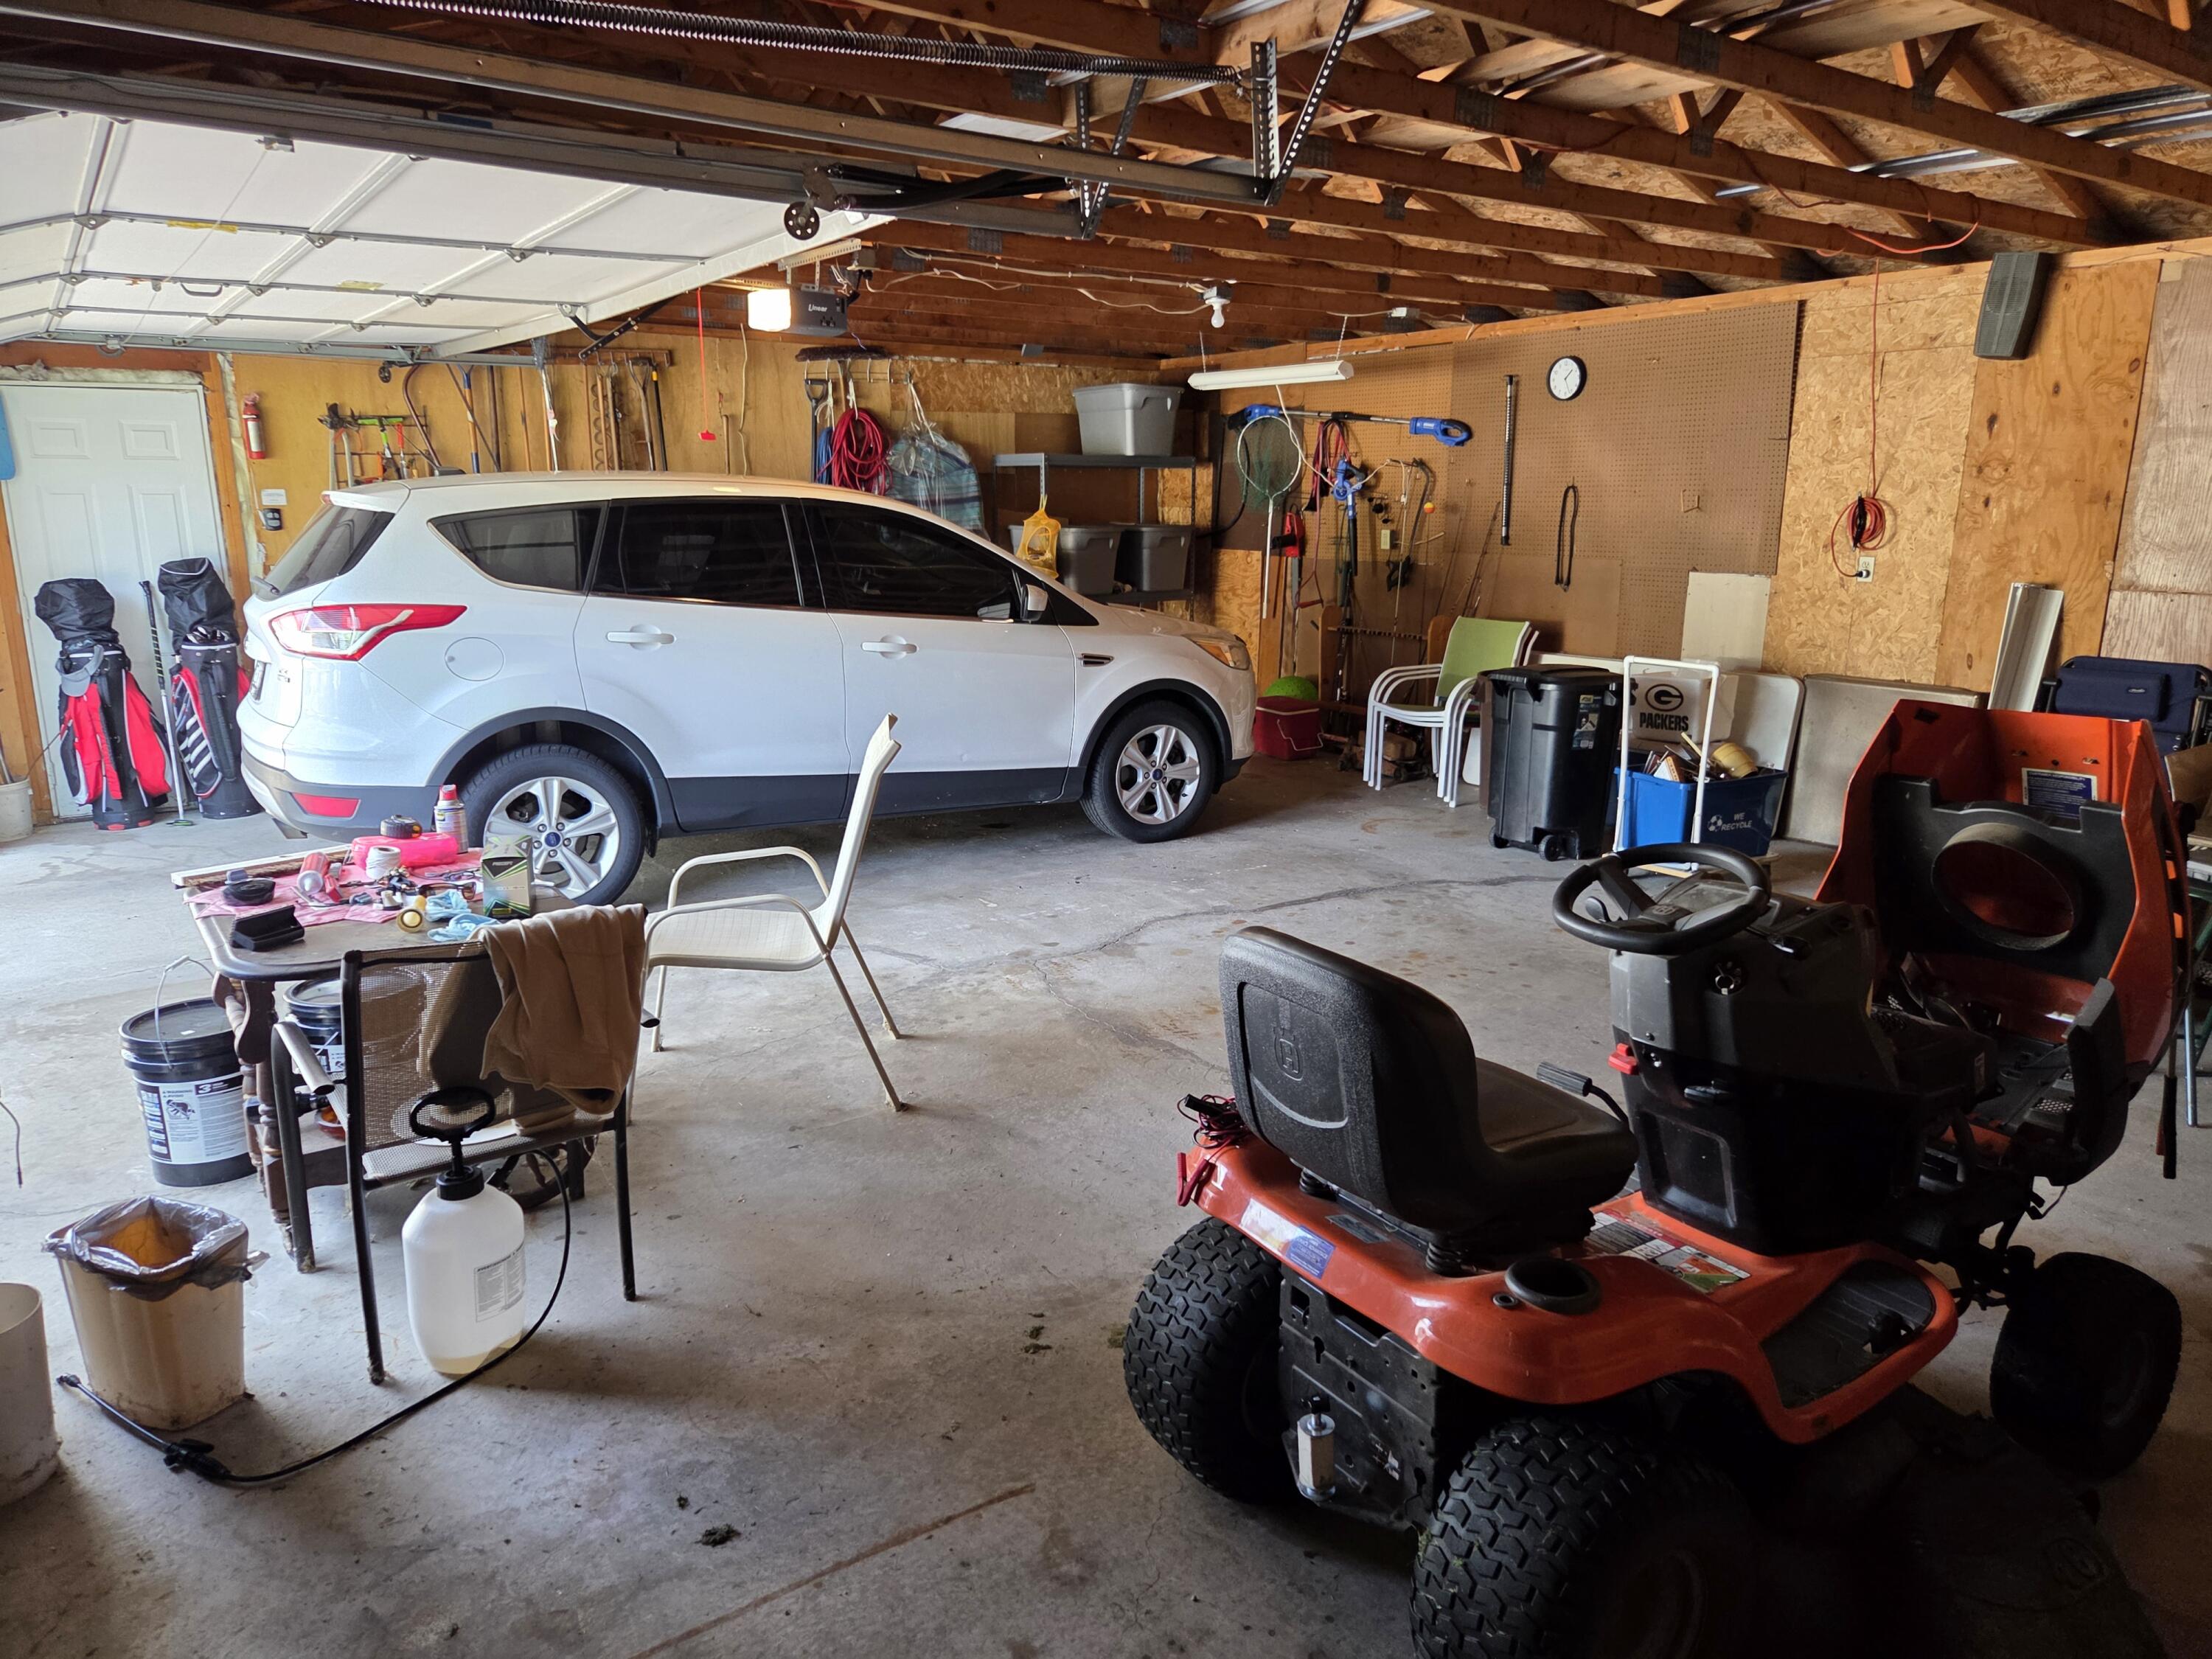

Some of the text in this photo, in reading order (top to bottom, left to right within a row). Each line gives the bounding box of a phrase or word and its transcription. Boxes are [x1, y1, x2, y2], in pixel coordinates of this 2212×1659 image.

[808, 304, 827, 312] Linear
[1639, 712, 1688, 731] PACKERS
[1733, 813, 1745, 821] WE
[1721, 820, 1753, 831] RECYCLE
[198, 1084, 212, 1093] 3
